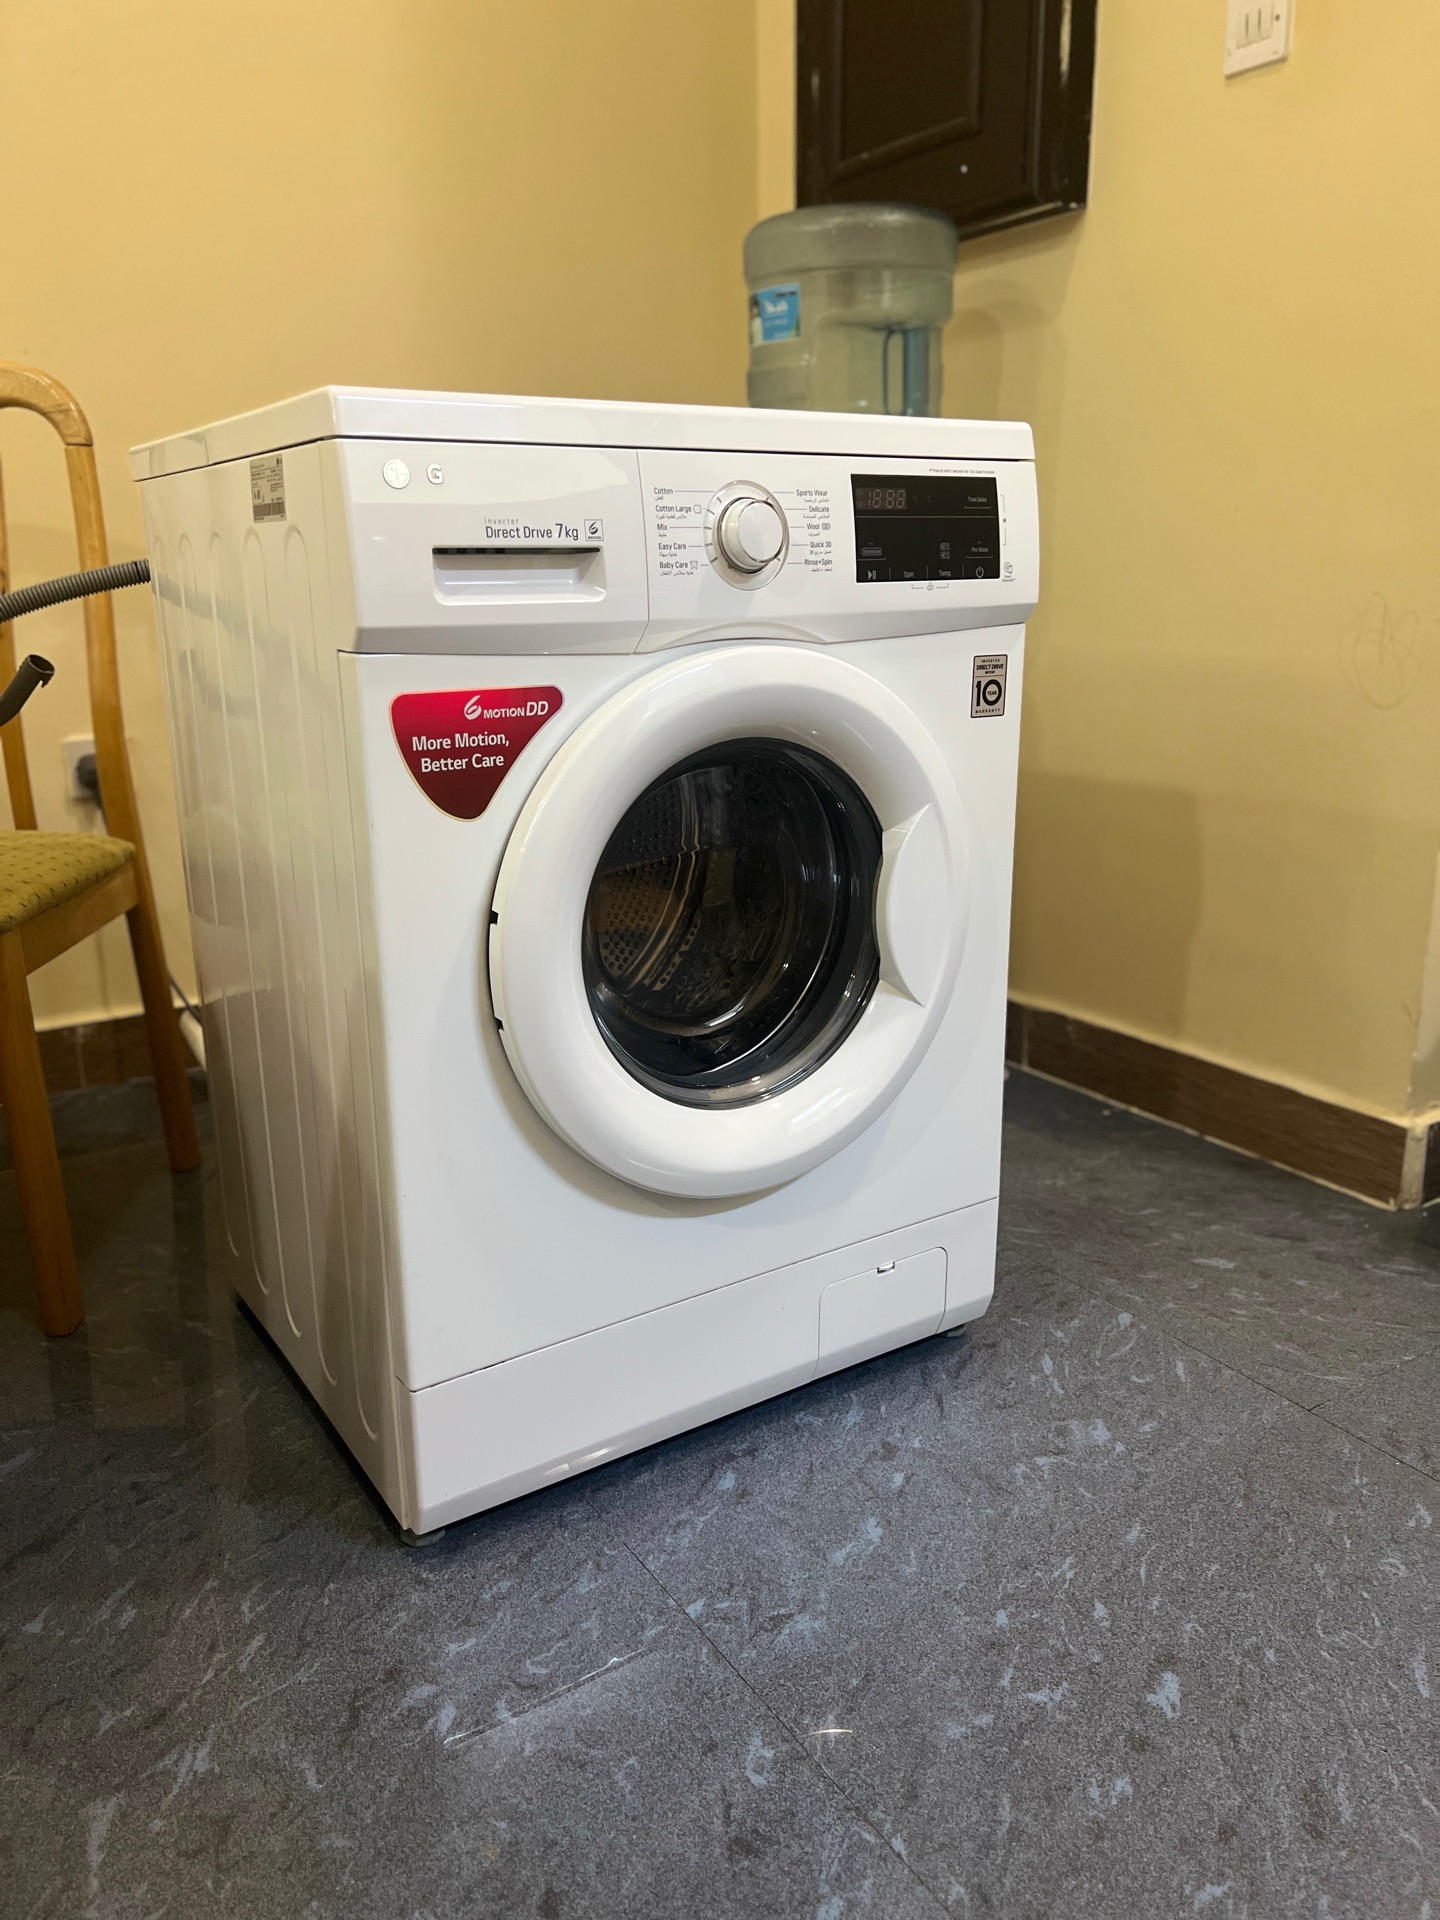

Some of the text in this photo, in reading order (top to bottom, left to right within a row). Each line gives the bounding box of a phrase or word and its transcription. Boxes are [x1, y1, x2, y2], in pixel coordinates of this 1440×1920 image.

[426, 463, 444, 485] G
[675, 505, 692, 514] Large
[485, 525, 521, 539] Direct
[523, 525, 553, 539] Drive
[658, 542, 673, 551] Easy
[659, 561, 674, 571] Baby
[804, 558, 833, 567] Rinse+Spin
[975, 679, 1002, 706] 10
[483, 707, 525, 719] MOTION
[412, 731, 510, 751] More Motion,
[421, 753, 504, 773] Better Care
